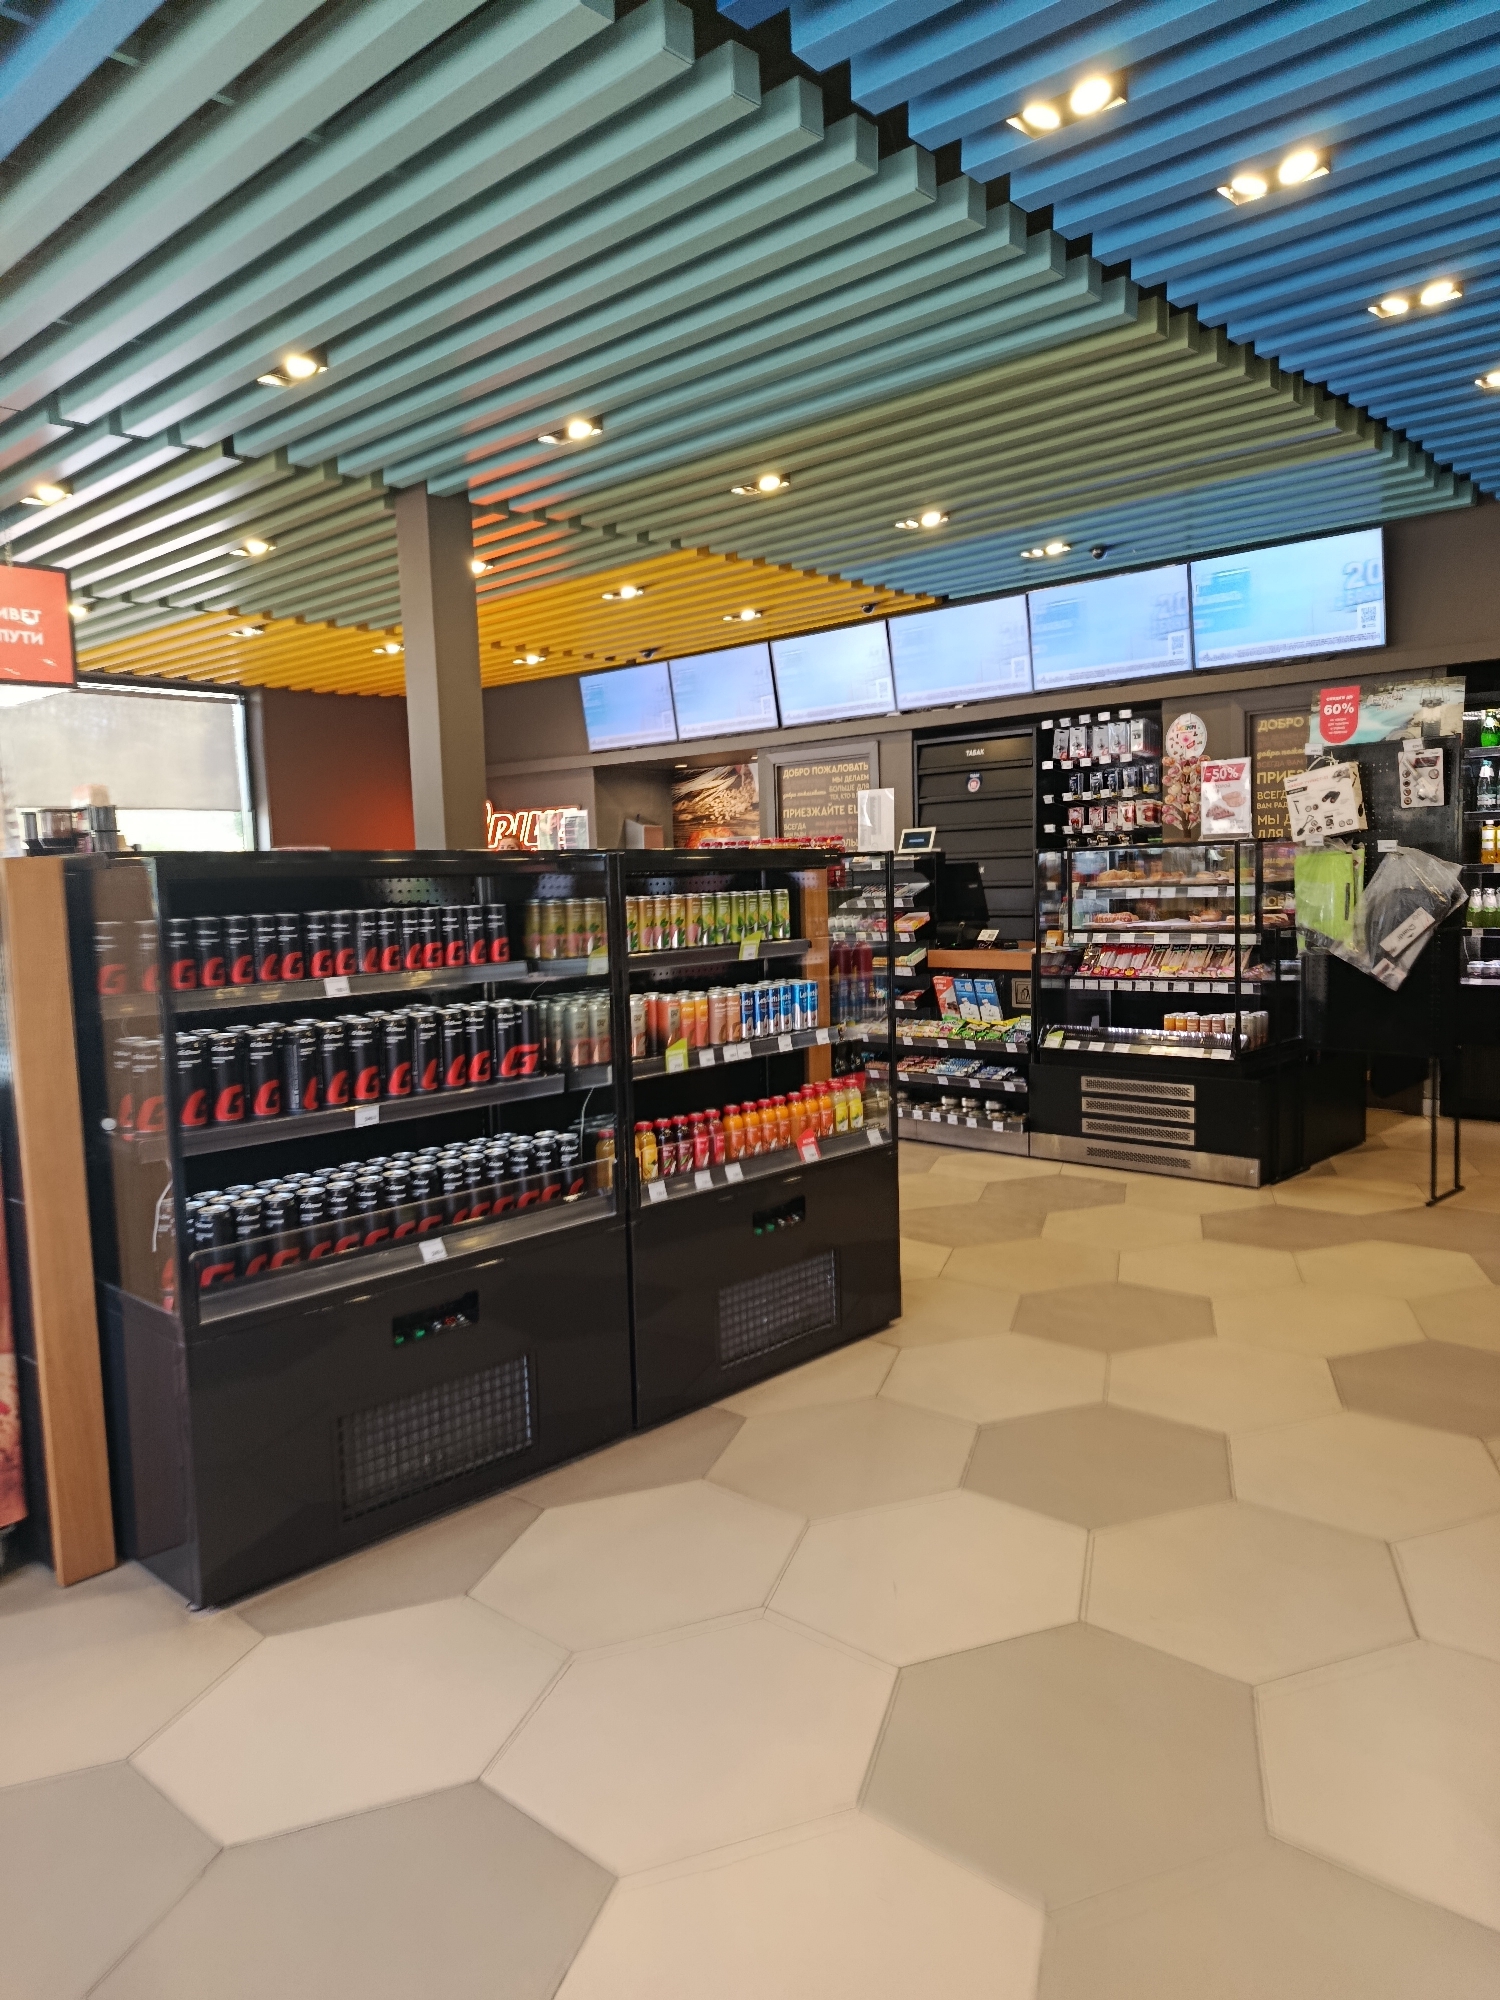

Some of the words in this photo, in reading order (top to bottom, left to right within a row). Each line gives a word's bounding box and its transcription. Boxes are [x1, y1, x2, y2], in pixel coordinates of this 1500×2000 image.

[1323, 703, 1355, 715] 60%
[1257, 716, 1304, 732] ДОБРО
[965, 749, 985, 757] ТАБАК
[783, 768, 810, 779] ДОБРО
[811, 762, 869, 775] ПОЖАЛОВАТЬ
[1205, 766, 1239, 780] -50%
[783, 803, 845, 818] ПРИЕЗЖАЙТЕ
[1257, 814, 1280, 826] МЫ
